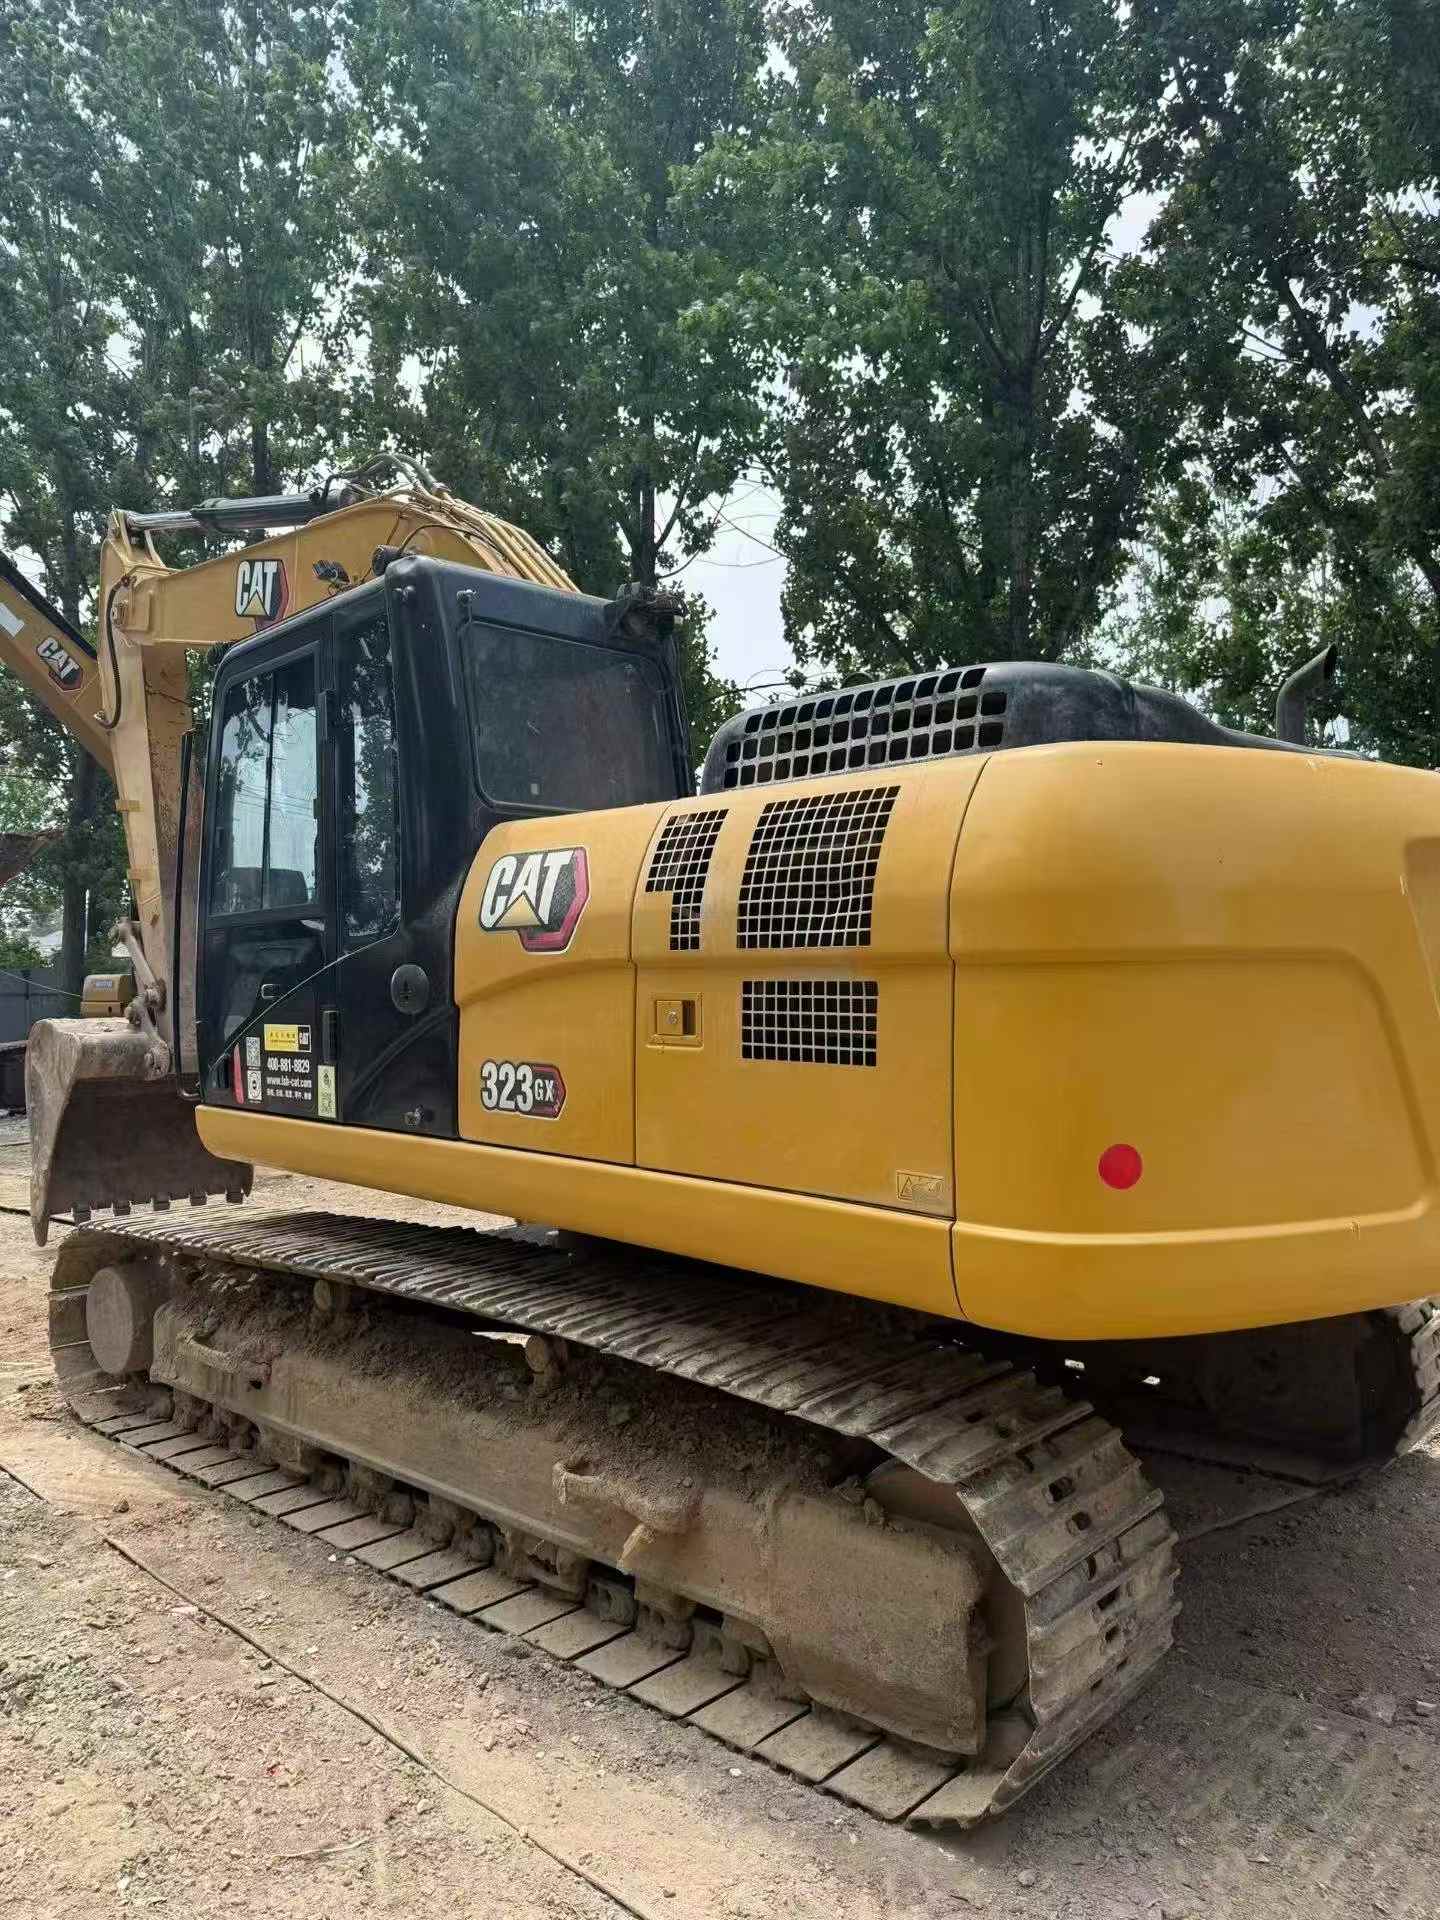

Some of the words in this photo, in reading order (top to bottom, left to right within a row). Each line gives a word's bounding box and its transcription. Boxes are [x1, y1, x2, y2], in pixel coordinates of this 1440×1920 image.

[236, 560, 278, 616] CAT
[37, 637, 80, 679] CAT
[481, 850, 575, 928] CAT
